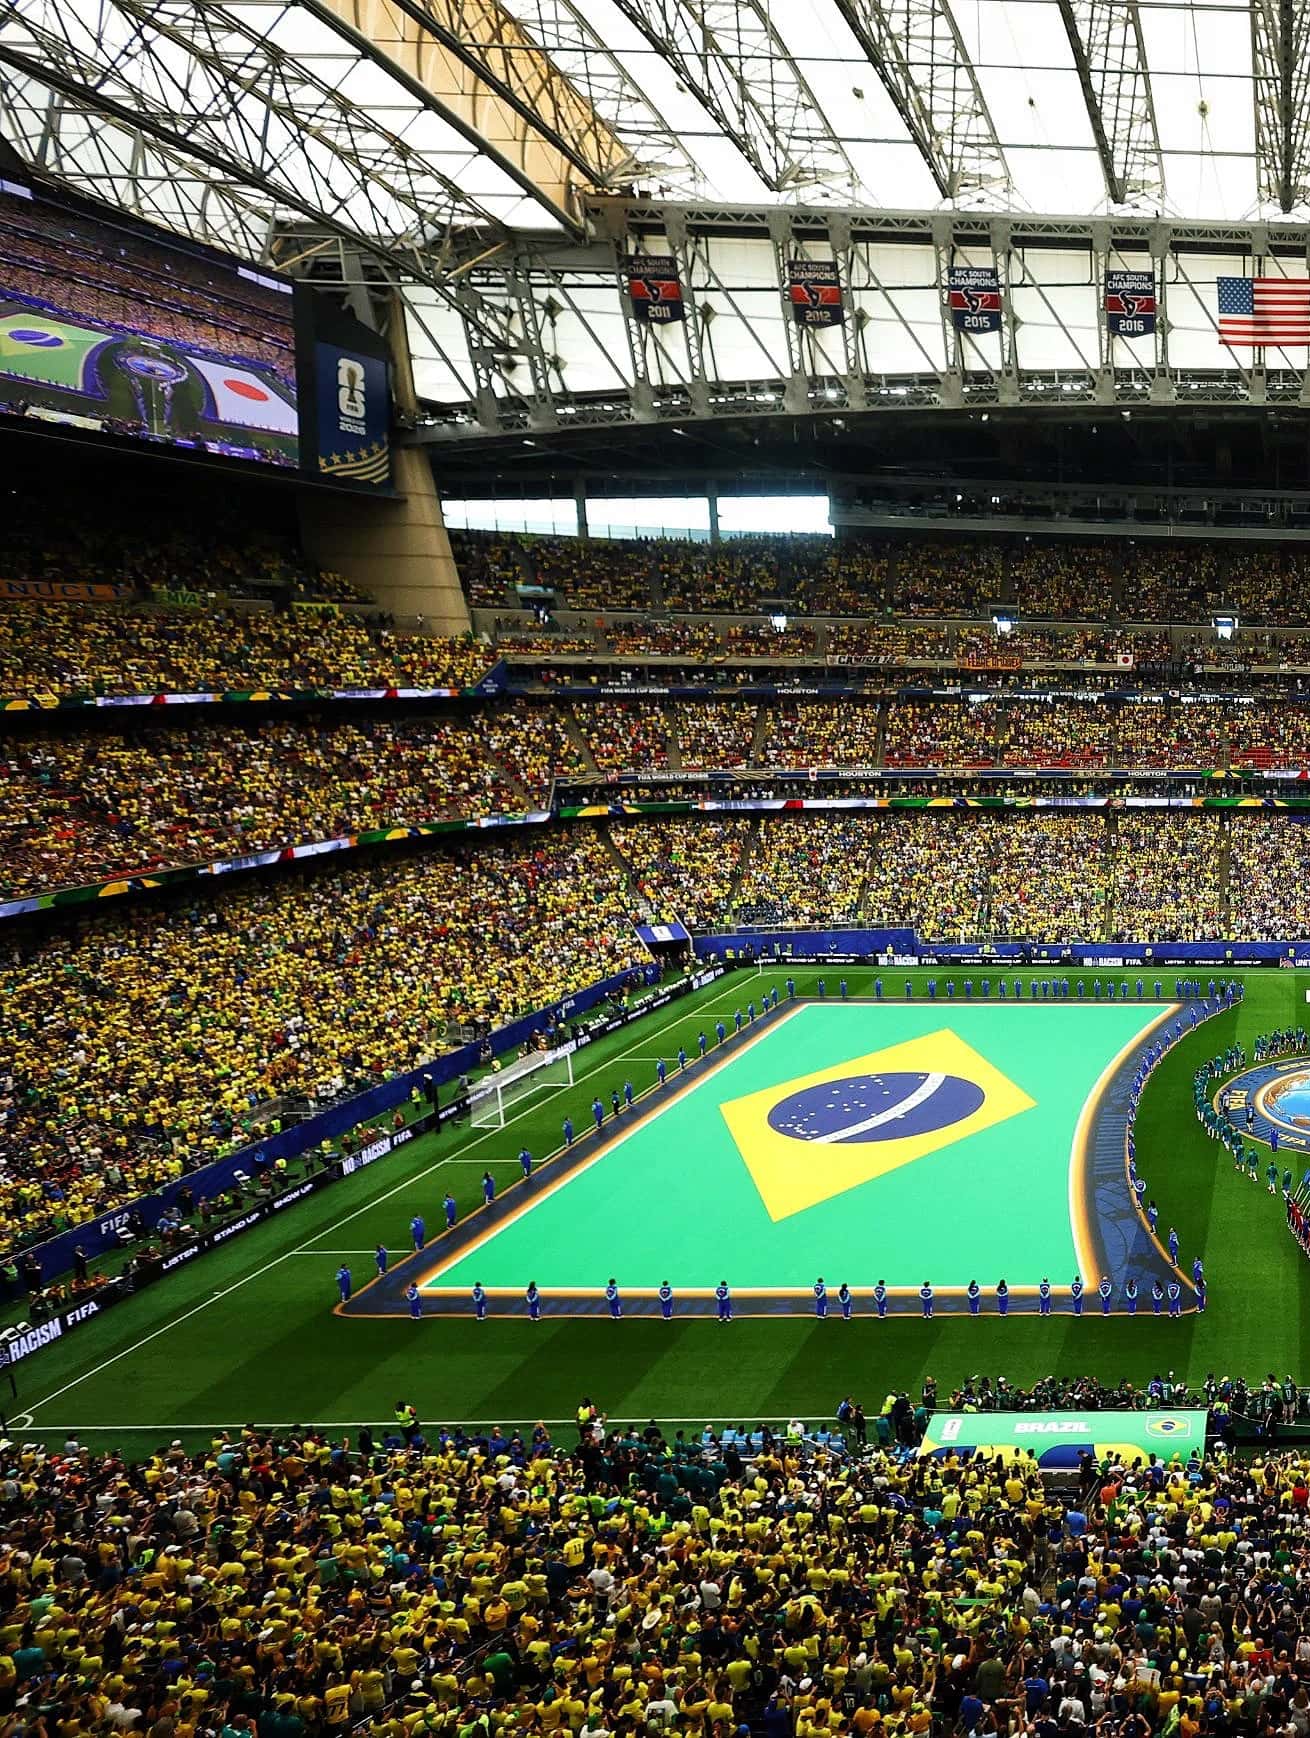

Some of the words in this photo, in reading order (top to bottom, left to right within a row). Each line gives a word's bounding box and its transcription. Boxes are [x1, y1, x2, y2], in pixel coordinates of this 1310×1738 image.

[806, 262, 831, 272] SOUTH
[790, 270, 837, 281] CHAMPIONS
[954, 269, 966, 278] AFC
[969, 270, 991, 279] SOUTH
[1112, 272, 1124, 281] AFC
[1126, 273, 1149, 283] SOUTH
[949, 275, 997, 288] CHAMPIONS
[1107, 280, 1153, 292] CHAMPIONS
[647, 306, 671, 319] 2011
[805, 309, 831, 321] 2012
[964, 315, 991, 329] 2015
[1119, 319, 1145, 332] 2016
[1125, 958, 1142, 966] FIFA
[1229, 1089, 1249, 1109] FIFA
[1278, 1132, 1307, 1147] FIFA
[342, 1157, 356, 1177] NO
[361, 1136, 391, 1166] RACISM
[393, 1129, 413, 1146] FIFA
[101, 1212, 131, 1235] FIFA
[162, 1245, 199, 1270] LISTEN
[213, 1219, 246, 1242] STAND
[246, 1212, 260, 1226] UP
[273, 1192, 301, 1210] SHOW
[300, 1183, 314, 1197] UP
[9, 1317, 63, 1363] RACISM
[66, 1300, 100, 1327] FIFA
[1014, 1420, 1091, 1434] BRAZIL
[574, 1543, 582, 1554] 11
